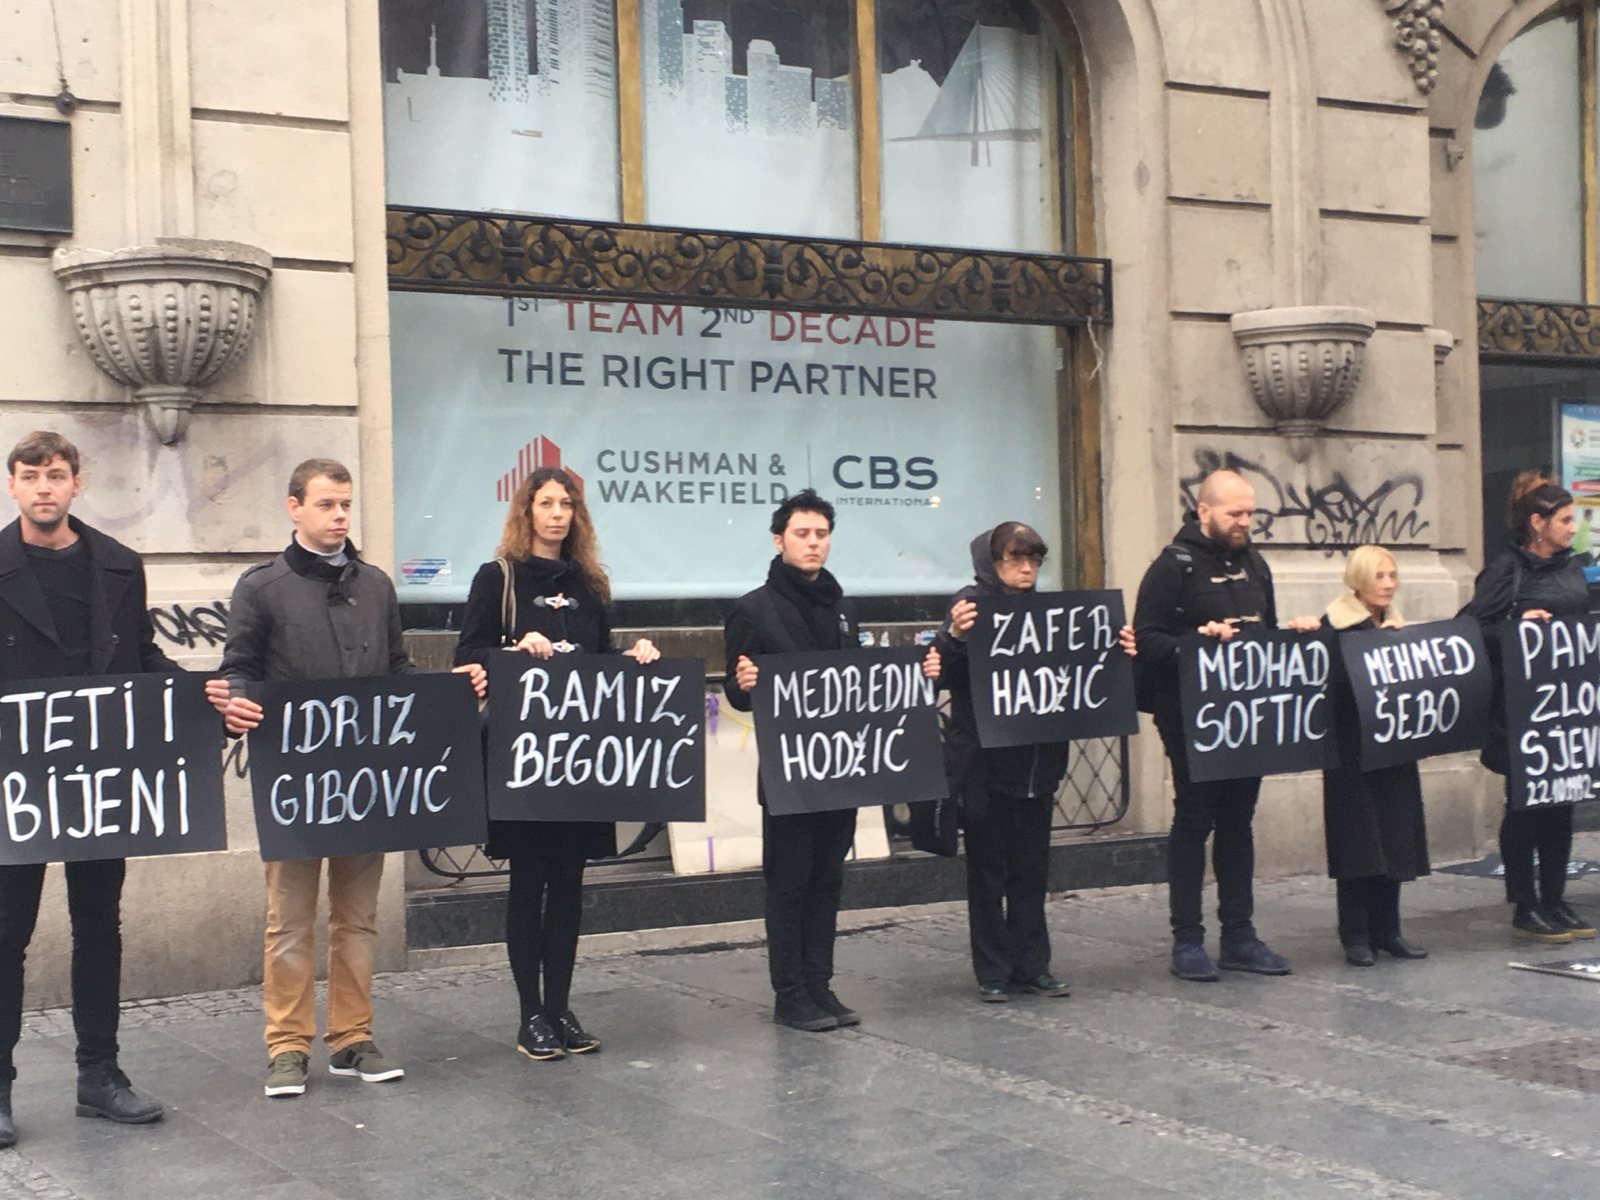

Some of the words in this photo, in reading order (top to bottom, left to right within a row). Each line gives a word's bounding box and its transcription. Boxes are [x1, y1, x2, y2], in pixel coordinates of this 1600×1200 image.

[560, 299, 683, 336] TEAM
[700, 307, 755, 338] 2ND
[769, 309, 936, 348] DECADE
[498, 349, 585, 386] THE
[602, 354, 735, 391] RIGHT
[751, 361, 937, 399] PARTNER
[597, 449, 757, 475] CUSHMAN
[768, 453, 786, 475] &
[833, 455, 938, 490] CBS
[597, 480, 788, 505] WAKEFIELD
[836, 497, 934, 507] INTERNATIONA
[991, 604, 1118, 657] ZAFER
[991, 651, 1108, 716] HADŽIĆ
[1198, 640, 1329, 692] MEDHAD
[1363, 635, 1476, 686] MEHMED
[0, 680, 135, 755] TETI
[519, 667, 686, 726] RAMIZ
[773, 662, 935, 719] MEDREDIN
[1194, 684, 1327, 752] SOFTIĆ
[1372, 686, 1460, 743] ŠEBO
[1526, 681, 1600, 722] ZLO
[281, 692, 416, 754] IDRIZ
[779, 714, 909, 782] HODŽIĆ
[1520, 725, 1600, 776] SJEV
[506, 724, 698, 789] BEGOVIĆ
[2, 757, 189, 842] BIJENI
[270, 746, 452, 827] GIBOVIĆ
